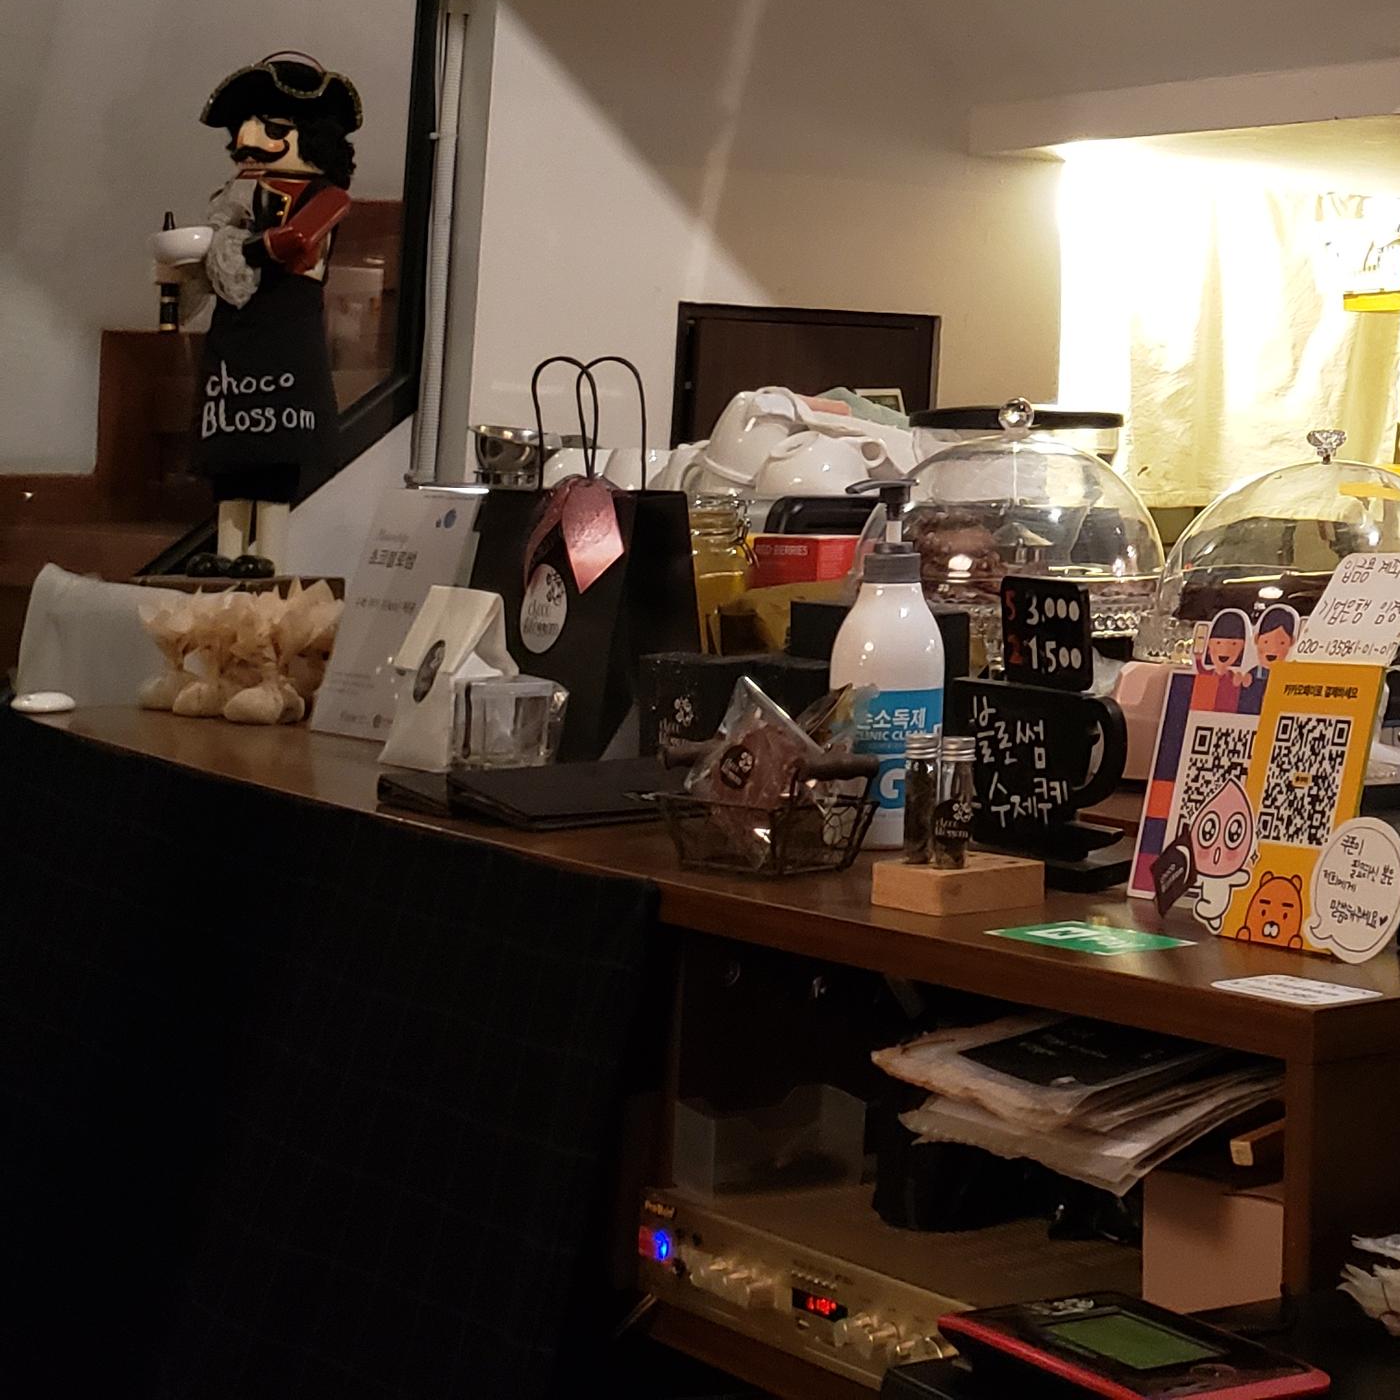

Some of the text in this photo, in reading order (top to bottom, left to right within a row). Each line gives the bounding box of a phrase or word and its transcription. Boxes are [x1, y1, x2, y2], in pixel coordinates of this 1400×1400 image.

[206, 360, 295, 396] choco
[1342, 557, 1376, 584] 입금용
[1319, 598, 1372, 625] 기업은행
